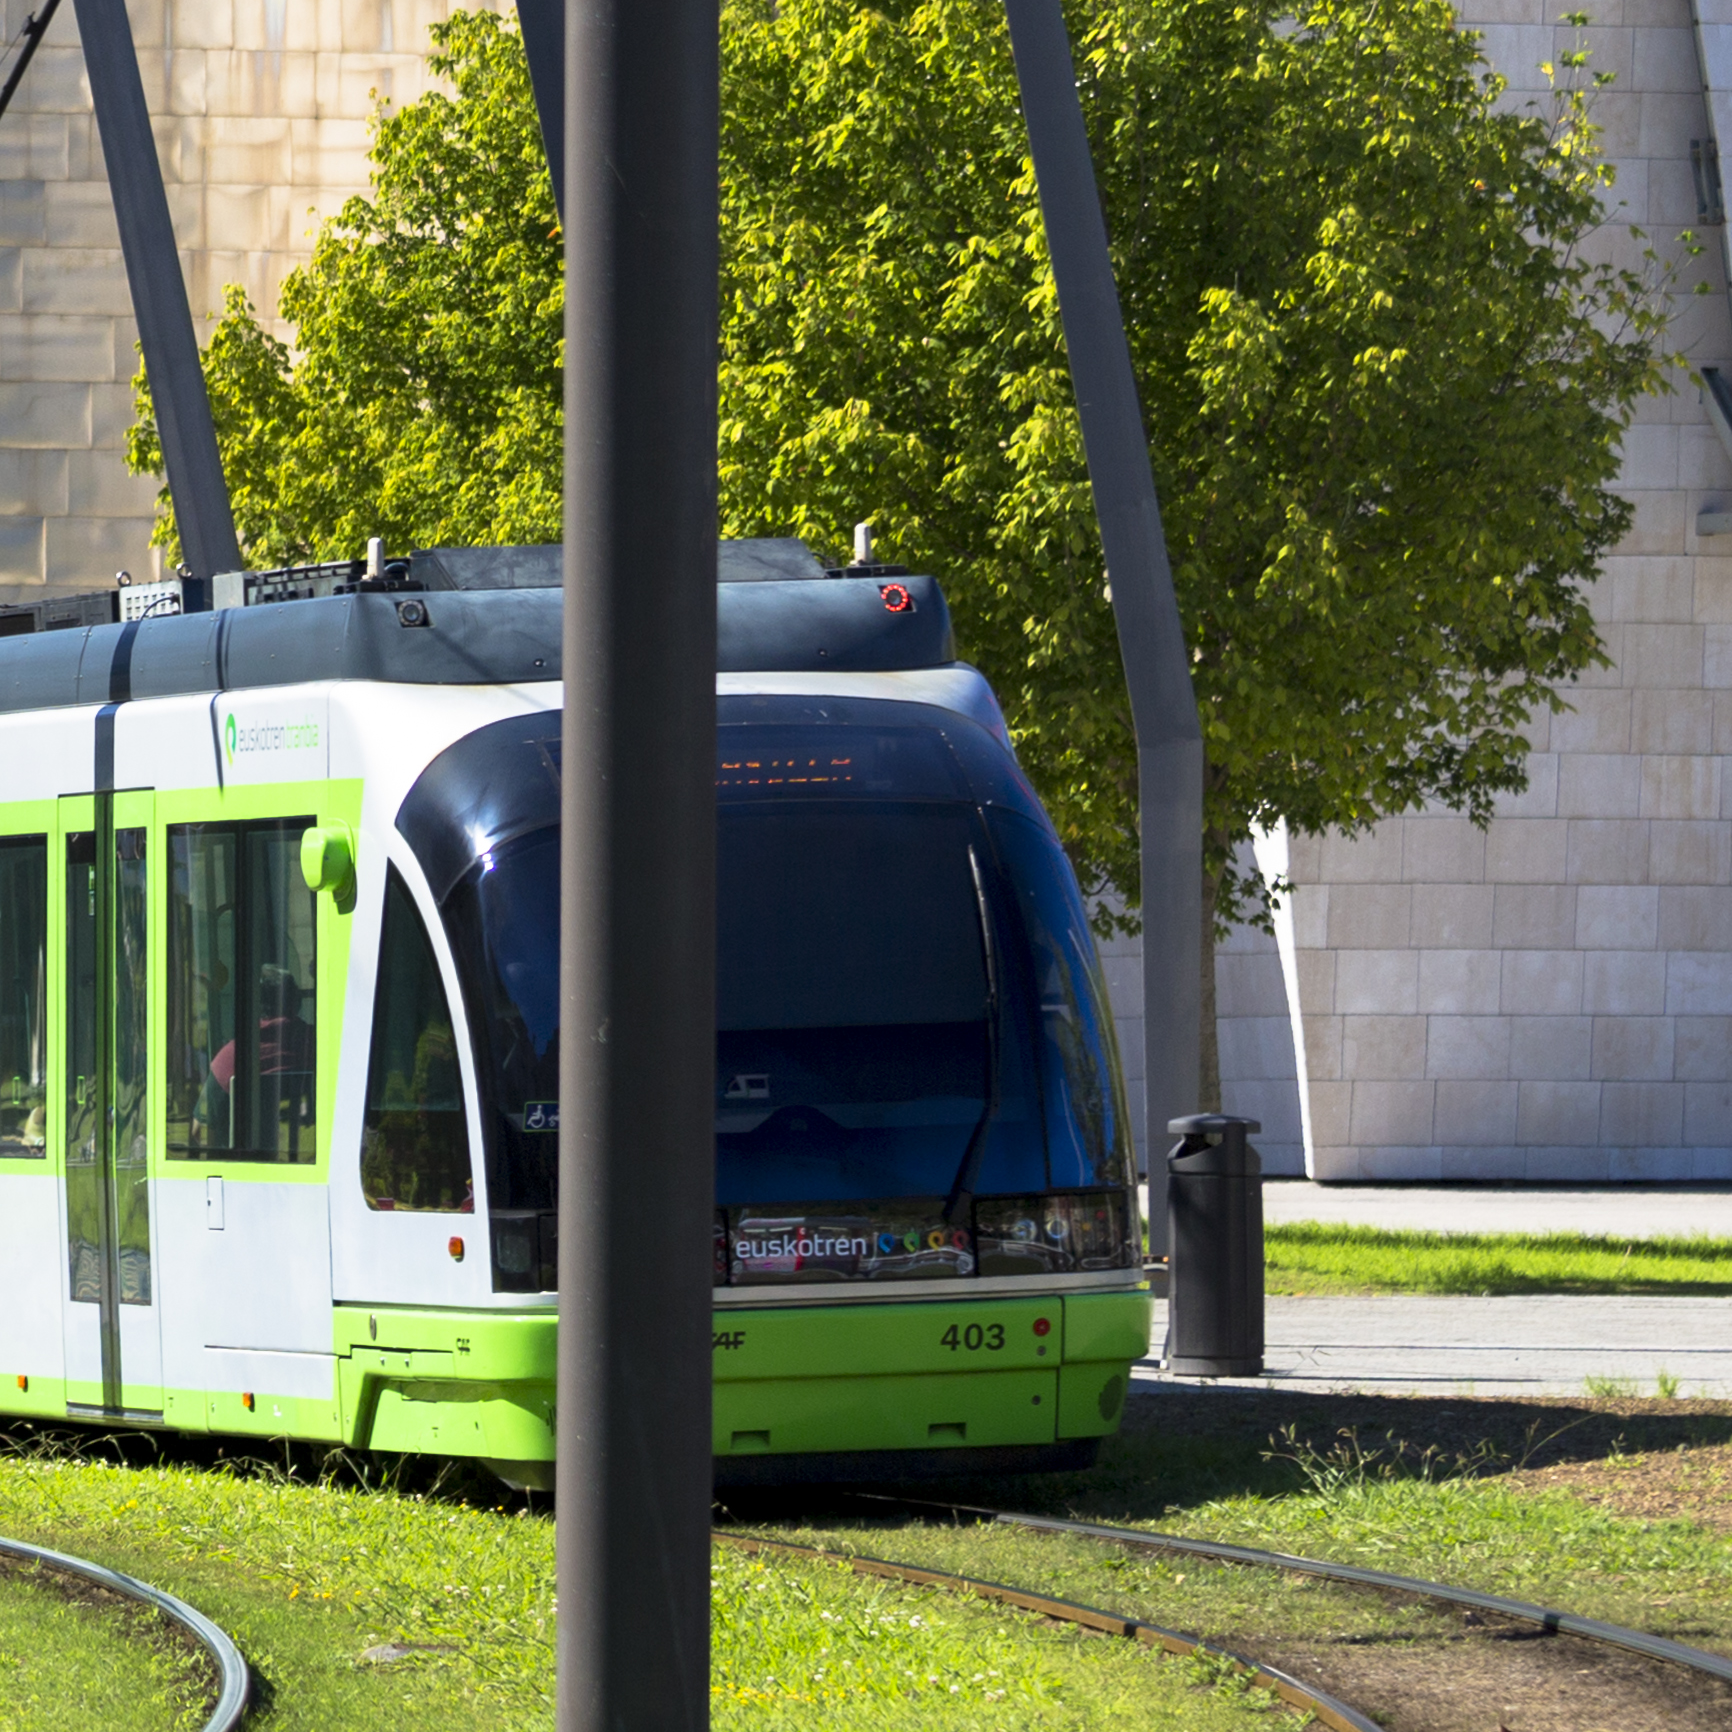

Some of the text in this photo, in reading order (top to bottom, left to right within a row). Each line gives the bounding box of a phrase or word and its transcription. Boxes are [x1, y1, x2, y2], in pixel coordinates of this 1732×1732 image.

[736, 1234, 867, 1259] euskotren
[712, 1331, 746, 1350] AF
[940, 1323, 1006, 1351] 403
